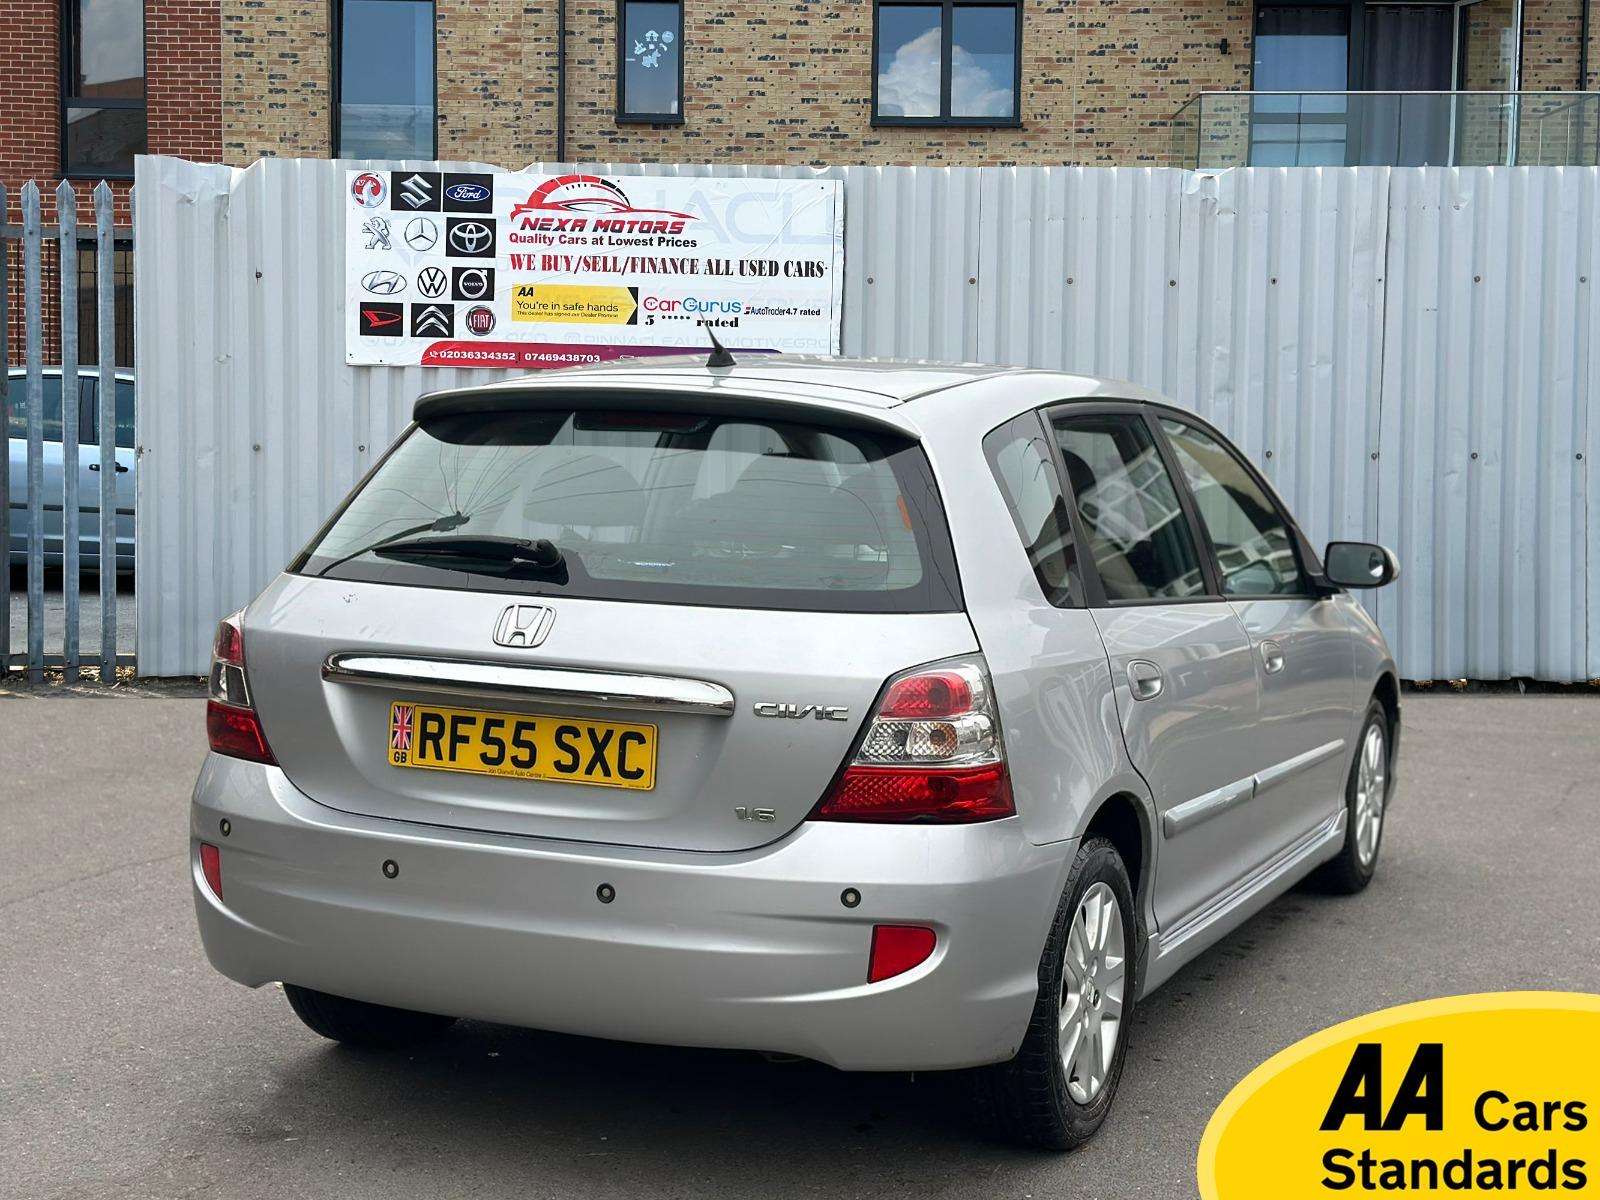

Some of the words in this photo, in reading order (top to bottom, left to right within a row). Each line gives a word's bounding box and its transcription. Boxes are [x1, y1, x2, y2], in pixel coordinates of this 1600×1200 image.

[454, 186, 482, 199] Ford
[520, 217, 587, 232] NEXA
[592, 219, 686, 235] MOTORS
[509, 233, 555, 246] Quality
[558, 234, 588, 245] Cars
[591, 236, 604, 246] at
[608, 236, 654, 247] Lowest
[657, 236, 697, 247] Prices
[510, 253, 536, 271] WE
[541, 254, 699, 275] BUY/SELL/FINANCE
[704, 258, 734, 276] ALL
[739, 259, 780, 277] USED
[783, 260, 825, 278] CARS
[518, 287, 534, 297] AA
[517, 301, 548, 310] You're
[551, 302, 560, 310] in
[562, 303, 585, 311] safe
[587, 303, 619, 312] hands
[643, 296, 741, 313] CarGurus
[473, 314, 490, 328] FIAT
[645, 315, 655, 326] 5
[697, 317, 739, 327] rated
[440, 351, 516, 360] 02036334352
[524, 352, 601, 362] 07469438703
[754, 702, 848, 721] CIVIC
[418, 712, 537, 769] RF55
[553, 725, 647, 780] SXC
[394, 751, 407, 763] GB
